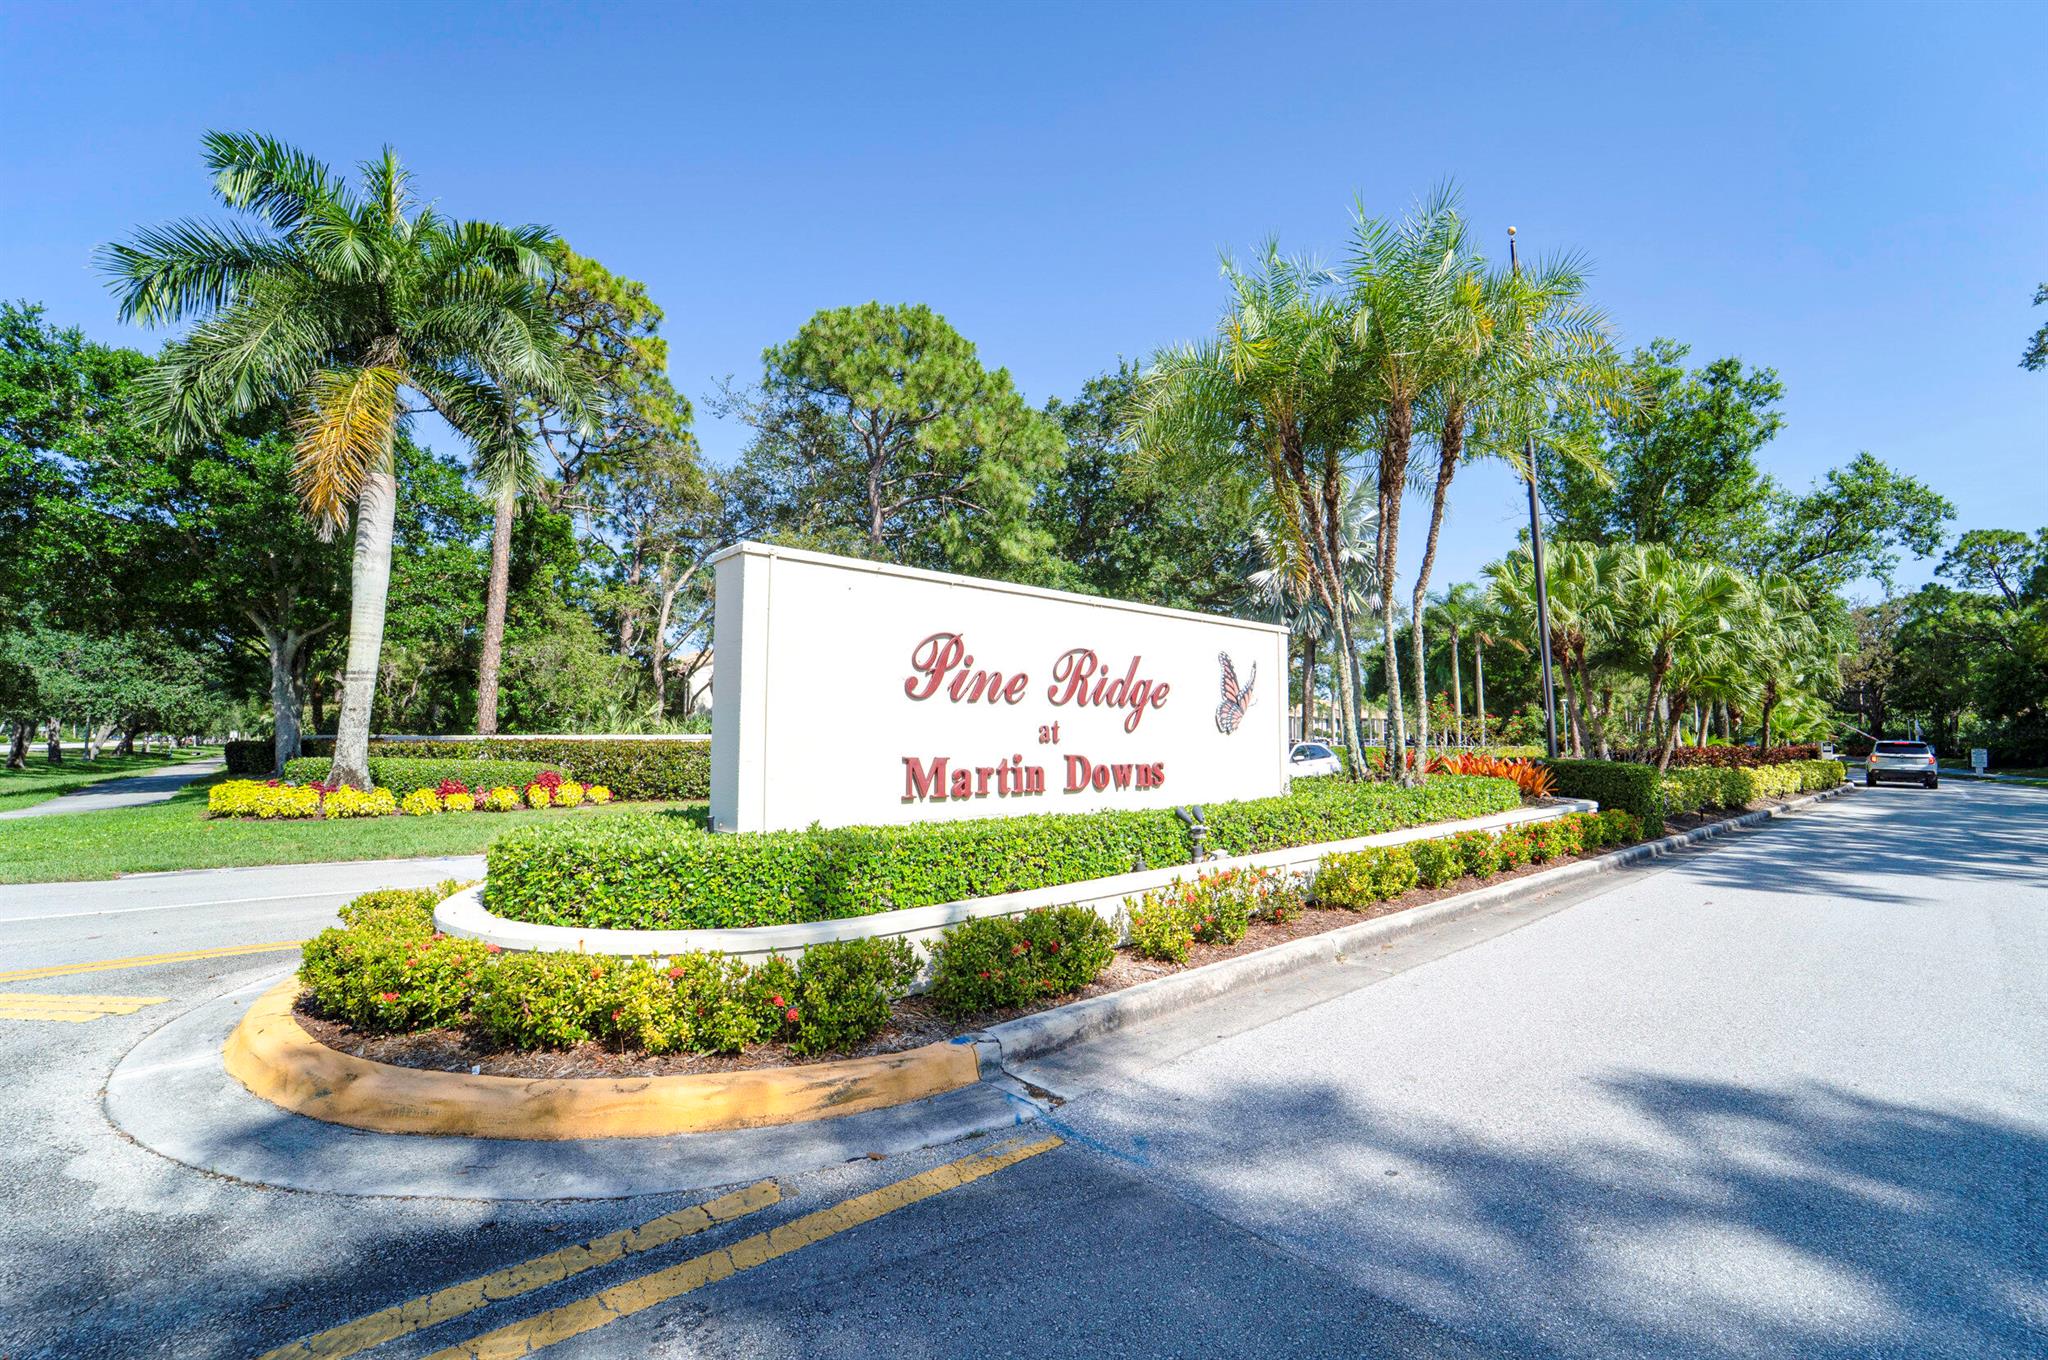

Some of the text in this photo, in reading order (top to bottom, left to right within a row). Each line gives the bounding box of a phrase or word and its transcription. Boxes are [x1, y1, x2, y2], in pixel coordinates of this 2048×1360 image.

[904, 632, 1170, 734] Pine Ridge
[1039, 721, 1060, 744] at
[901, 754, 1165, 803] Martin Downs
